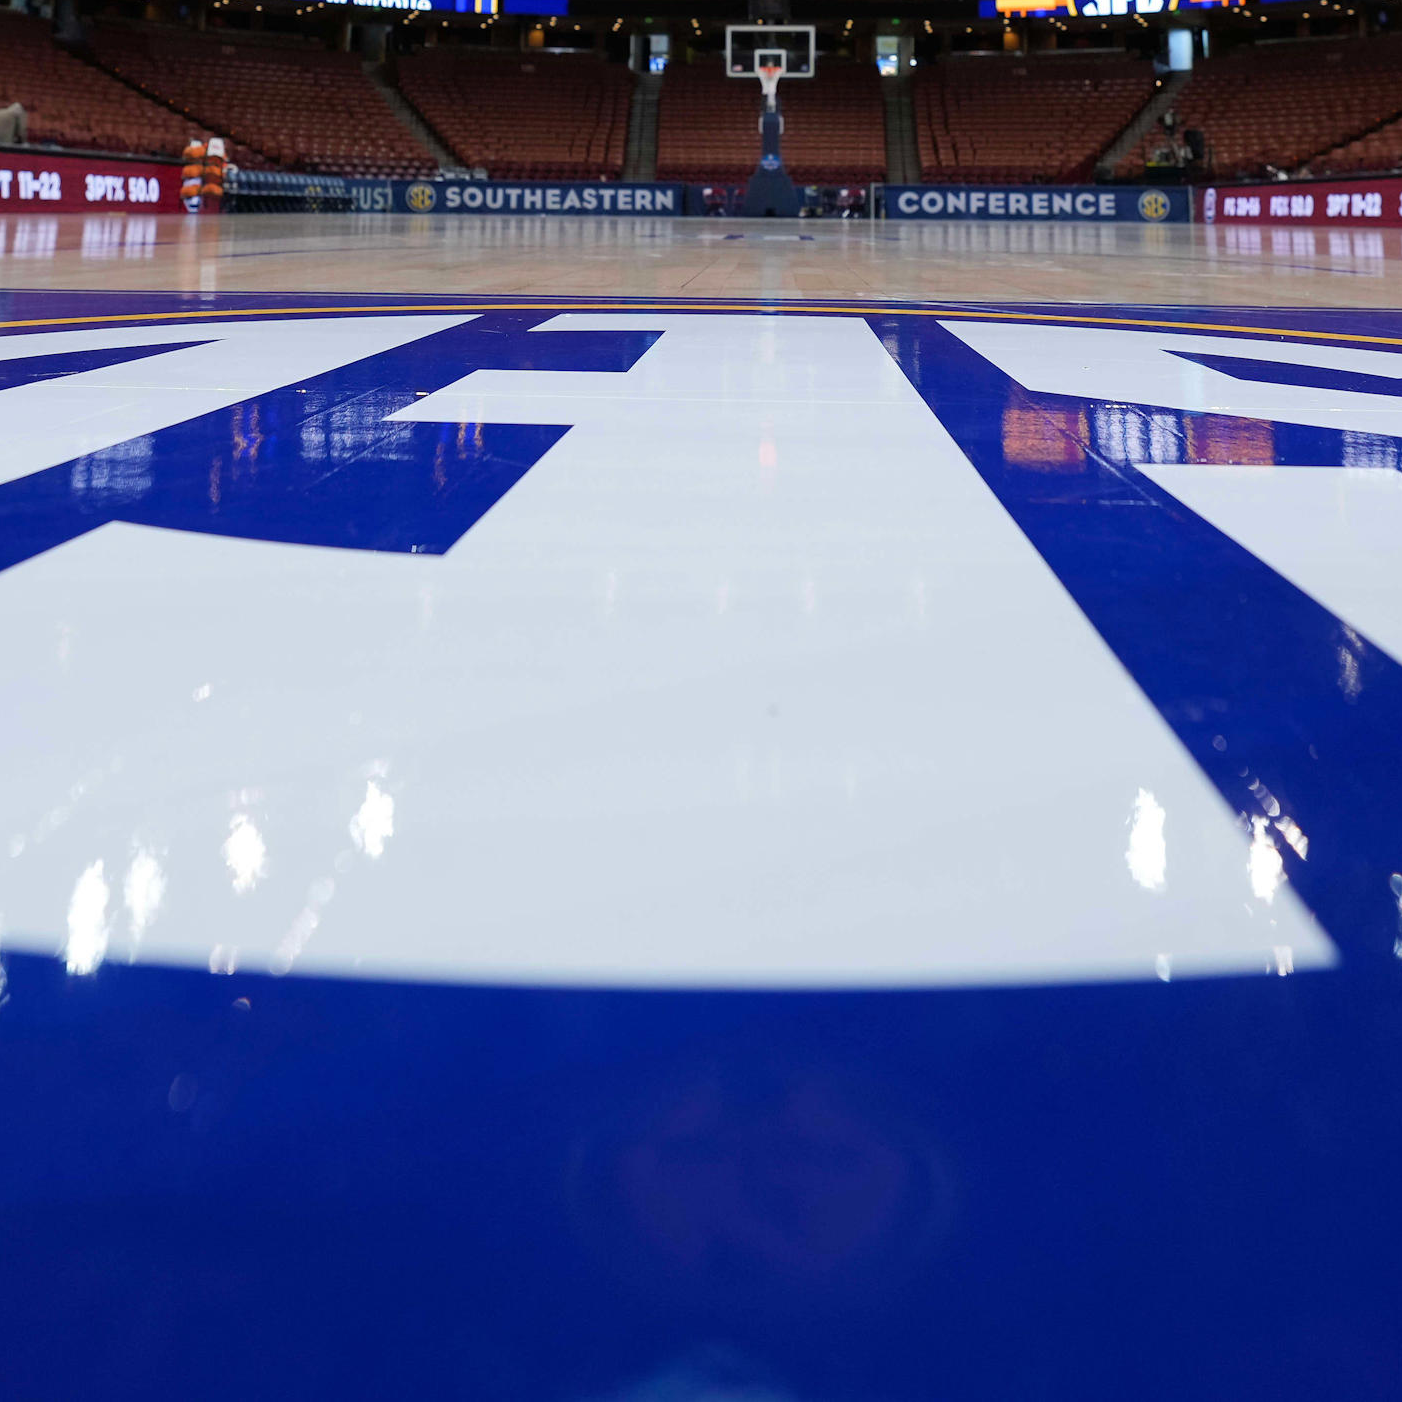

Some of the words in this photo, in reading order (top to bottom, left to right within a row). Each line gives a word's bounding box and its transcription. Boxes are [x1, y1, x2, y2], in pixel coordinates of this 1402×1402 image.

[17, 169, 62, 201] 11-22
[84, 173, 125, 203] 3PT%
[128, 176, 160, 204] 50.0
[444, 186, 675, 211] SOUTHEASTERN
[897, 191, 1117, 216] CONFERENCE
